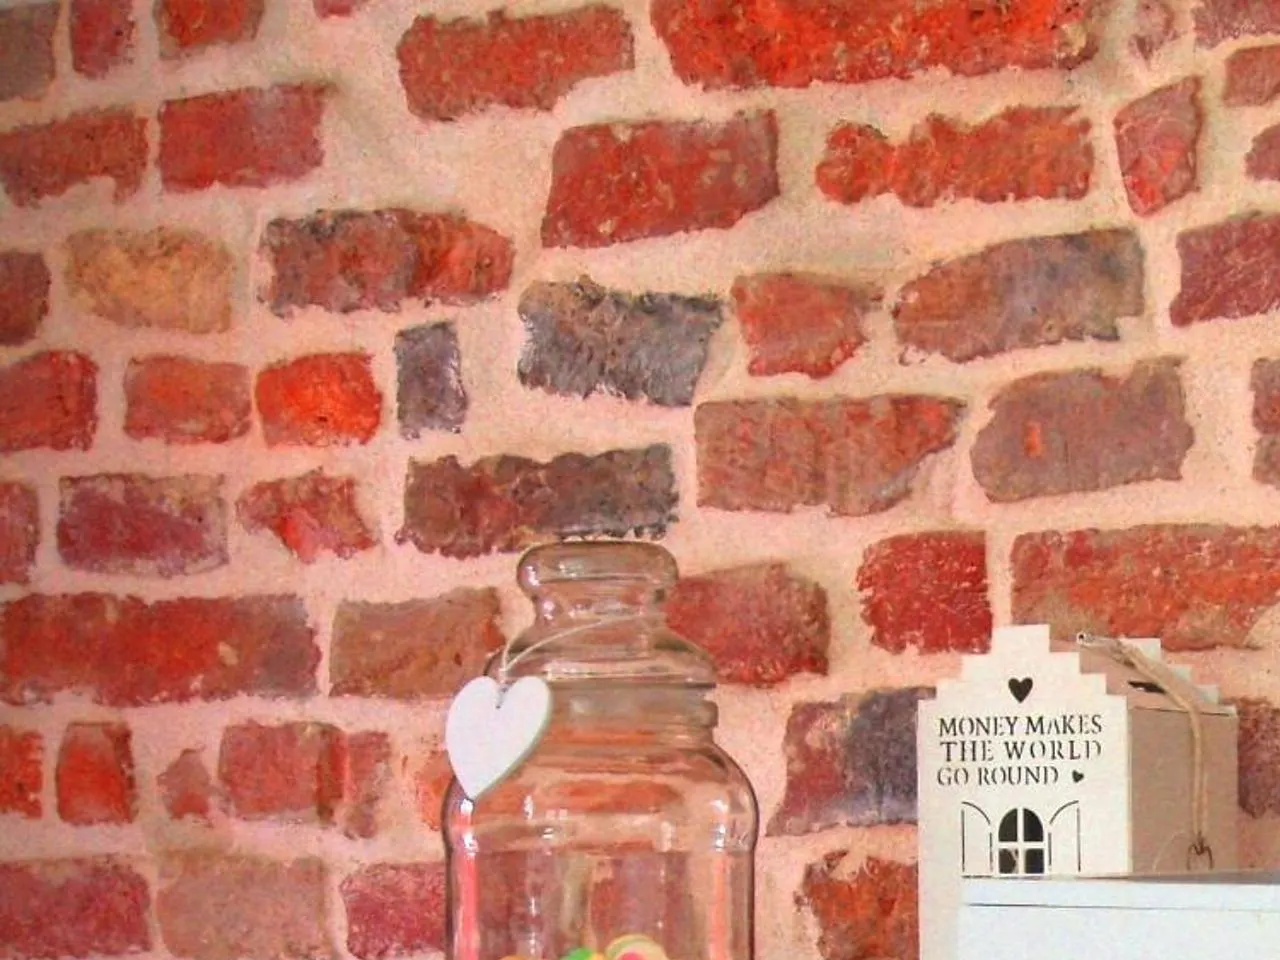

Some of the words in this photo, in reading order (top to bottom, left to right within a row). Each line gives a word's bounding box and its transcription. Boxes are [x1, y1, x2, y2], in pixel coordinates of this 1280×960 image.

[939, 715, 1019, 737] MONEY
[1025, 714, 1103, 735] MAKES
[940, 740, 994, 762] THE
[1004, 740, 1102, 761] WORLD
[937, 767, 969, 787] GO
[977, 766, 1059, 786] ROUND
